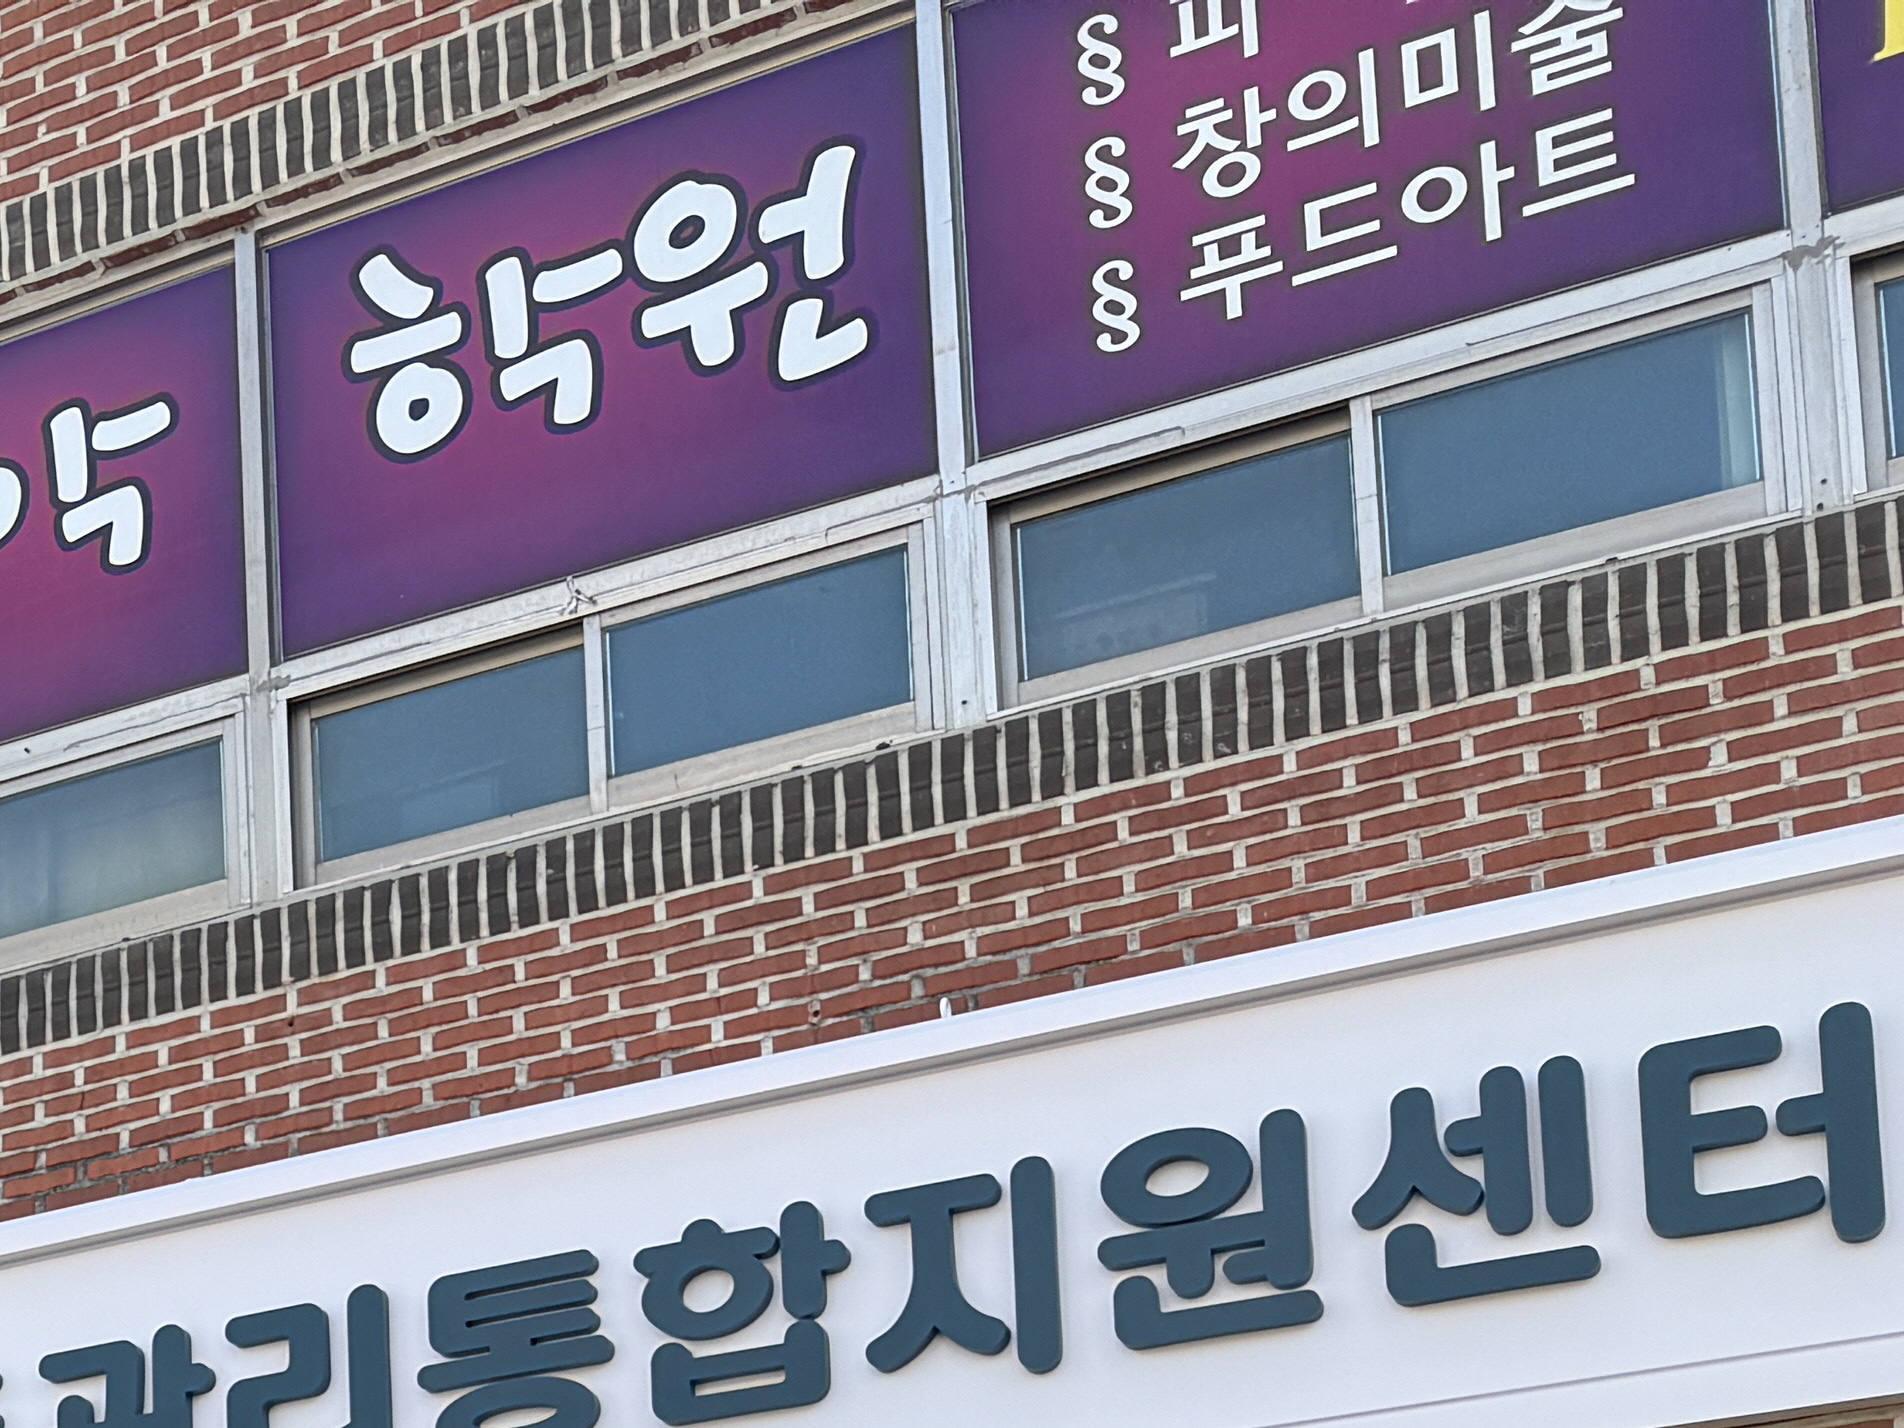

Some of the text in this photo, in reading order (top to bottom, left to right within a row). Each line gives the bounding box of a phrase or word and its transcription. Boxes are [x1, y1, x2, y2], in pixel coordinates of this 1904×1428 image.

[1172, 0, 1624, 198] 창의미술
[348, 144, 870, 456] 학원
[1179, 108, 1636, 321] 푸드아트
